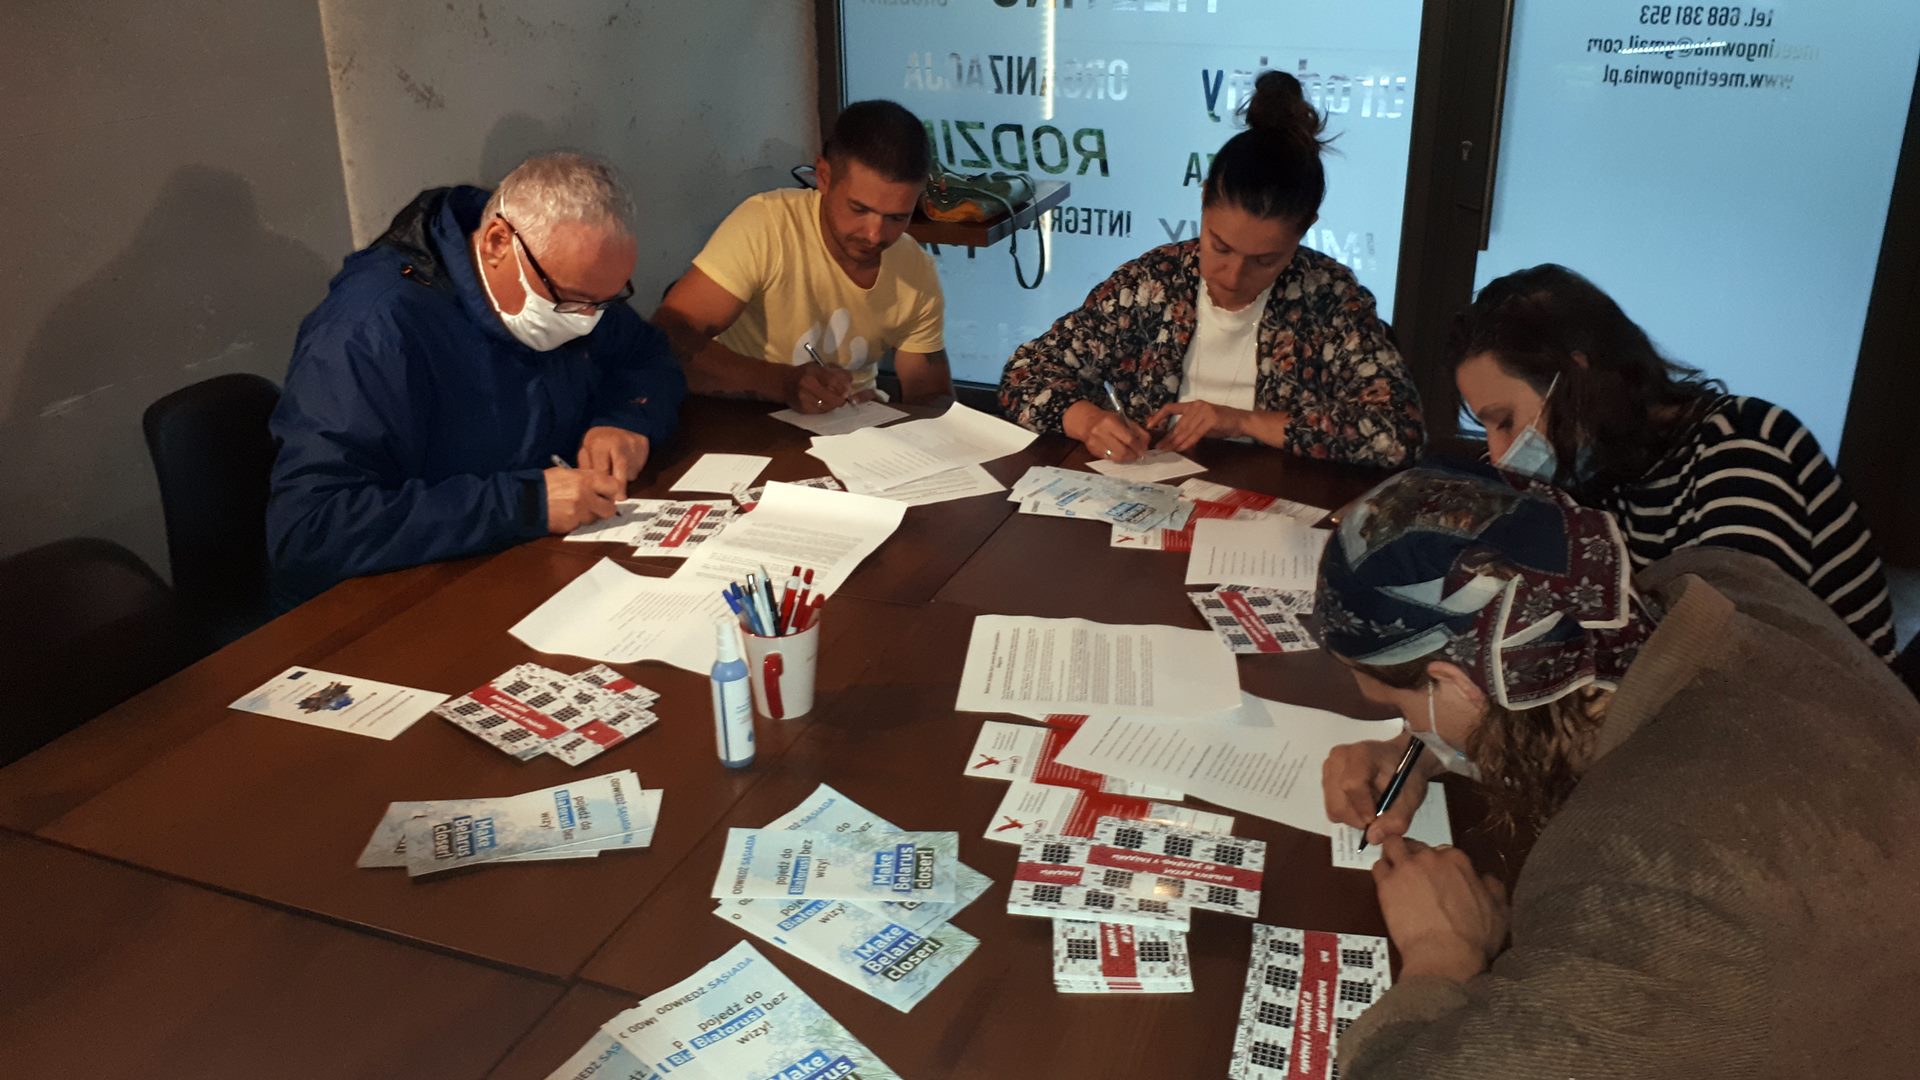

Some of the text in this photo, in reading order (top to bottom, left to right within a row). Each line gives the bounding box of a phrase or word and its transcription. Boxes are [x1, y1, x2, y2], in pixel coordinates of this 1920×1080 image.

[455, 817, 473, 858] Belarus
[474, 817, 493, 849] Make
[799, 839, 813, 855] bez
[784, 848, 793, 859] do
[873, 853, 893, 885] Make
[893, 846, 914, 891] Belarus
[917, 848, 934, 889] closer!
[862, 926, 900, 957] Make
[866, 936, 925, 973] Belaru
[888, 941, 939, 981] closer!
[744, 990, 763, 1005] do
[761, 991, 788, 1012] bez
[736, 1020, 775, 1045] wizy!
